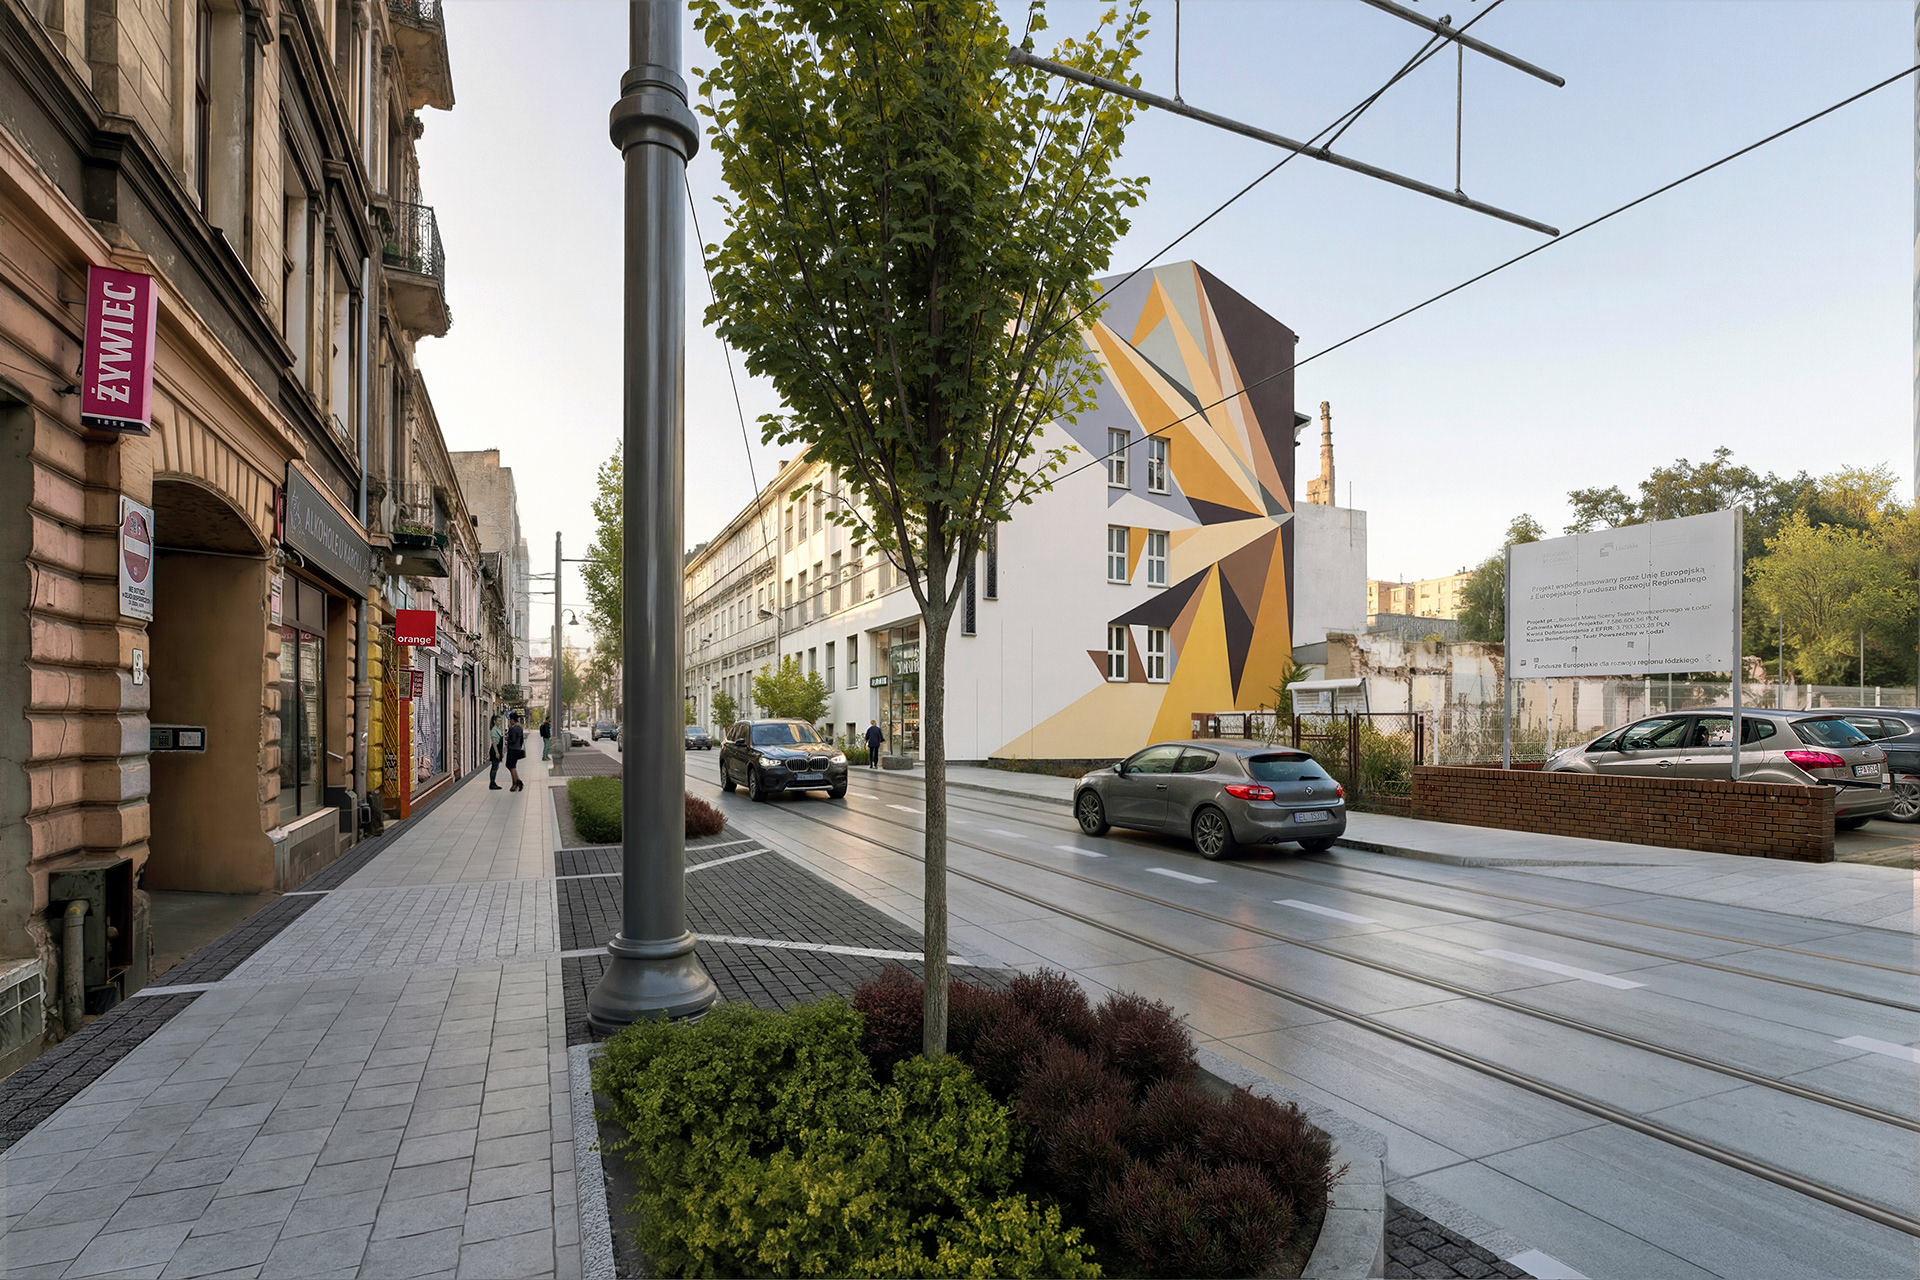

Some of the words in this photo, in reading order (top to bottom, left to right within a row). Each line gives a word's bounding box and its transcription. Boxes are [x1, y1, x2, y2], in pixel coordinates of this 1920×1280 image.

[91, 281, 136, 404] ŻYWIEC
[97, 419, 125, 427] 1856
[1620, 575, 1639, 583] przez
[1535, 589, 1581, 600] Europejskiego
[1583, 585, 1617, 594] Funduszu
[1619, 581, 1650, 590] Rozwoju
[1652, 576, 1707, 587] Regionalnego
[397, 636, 432, 646] orange
